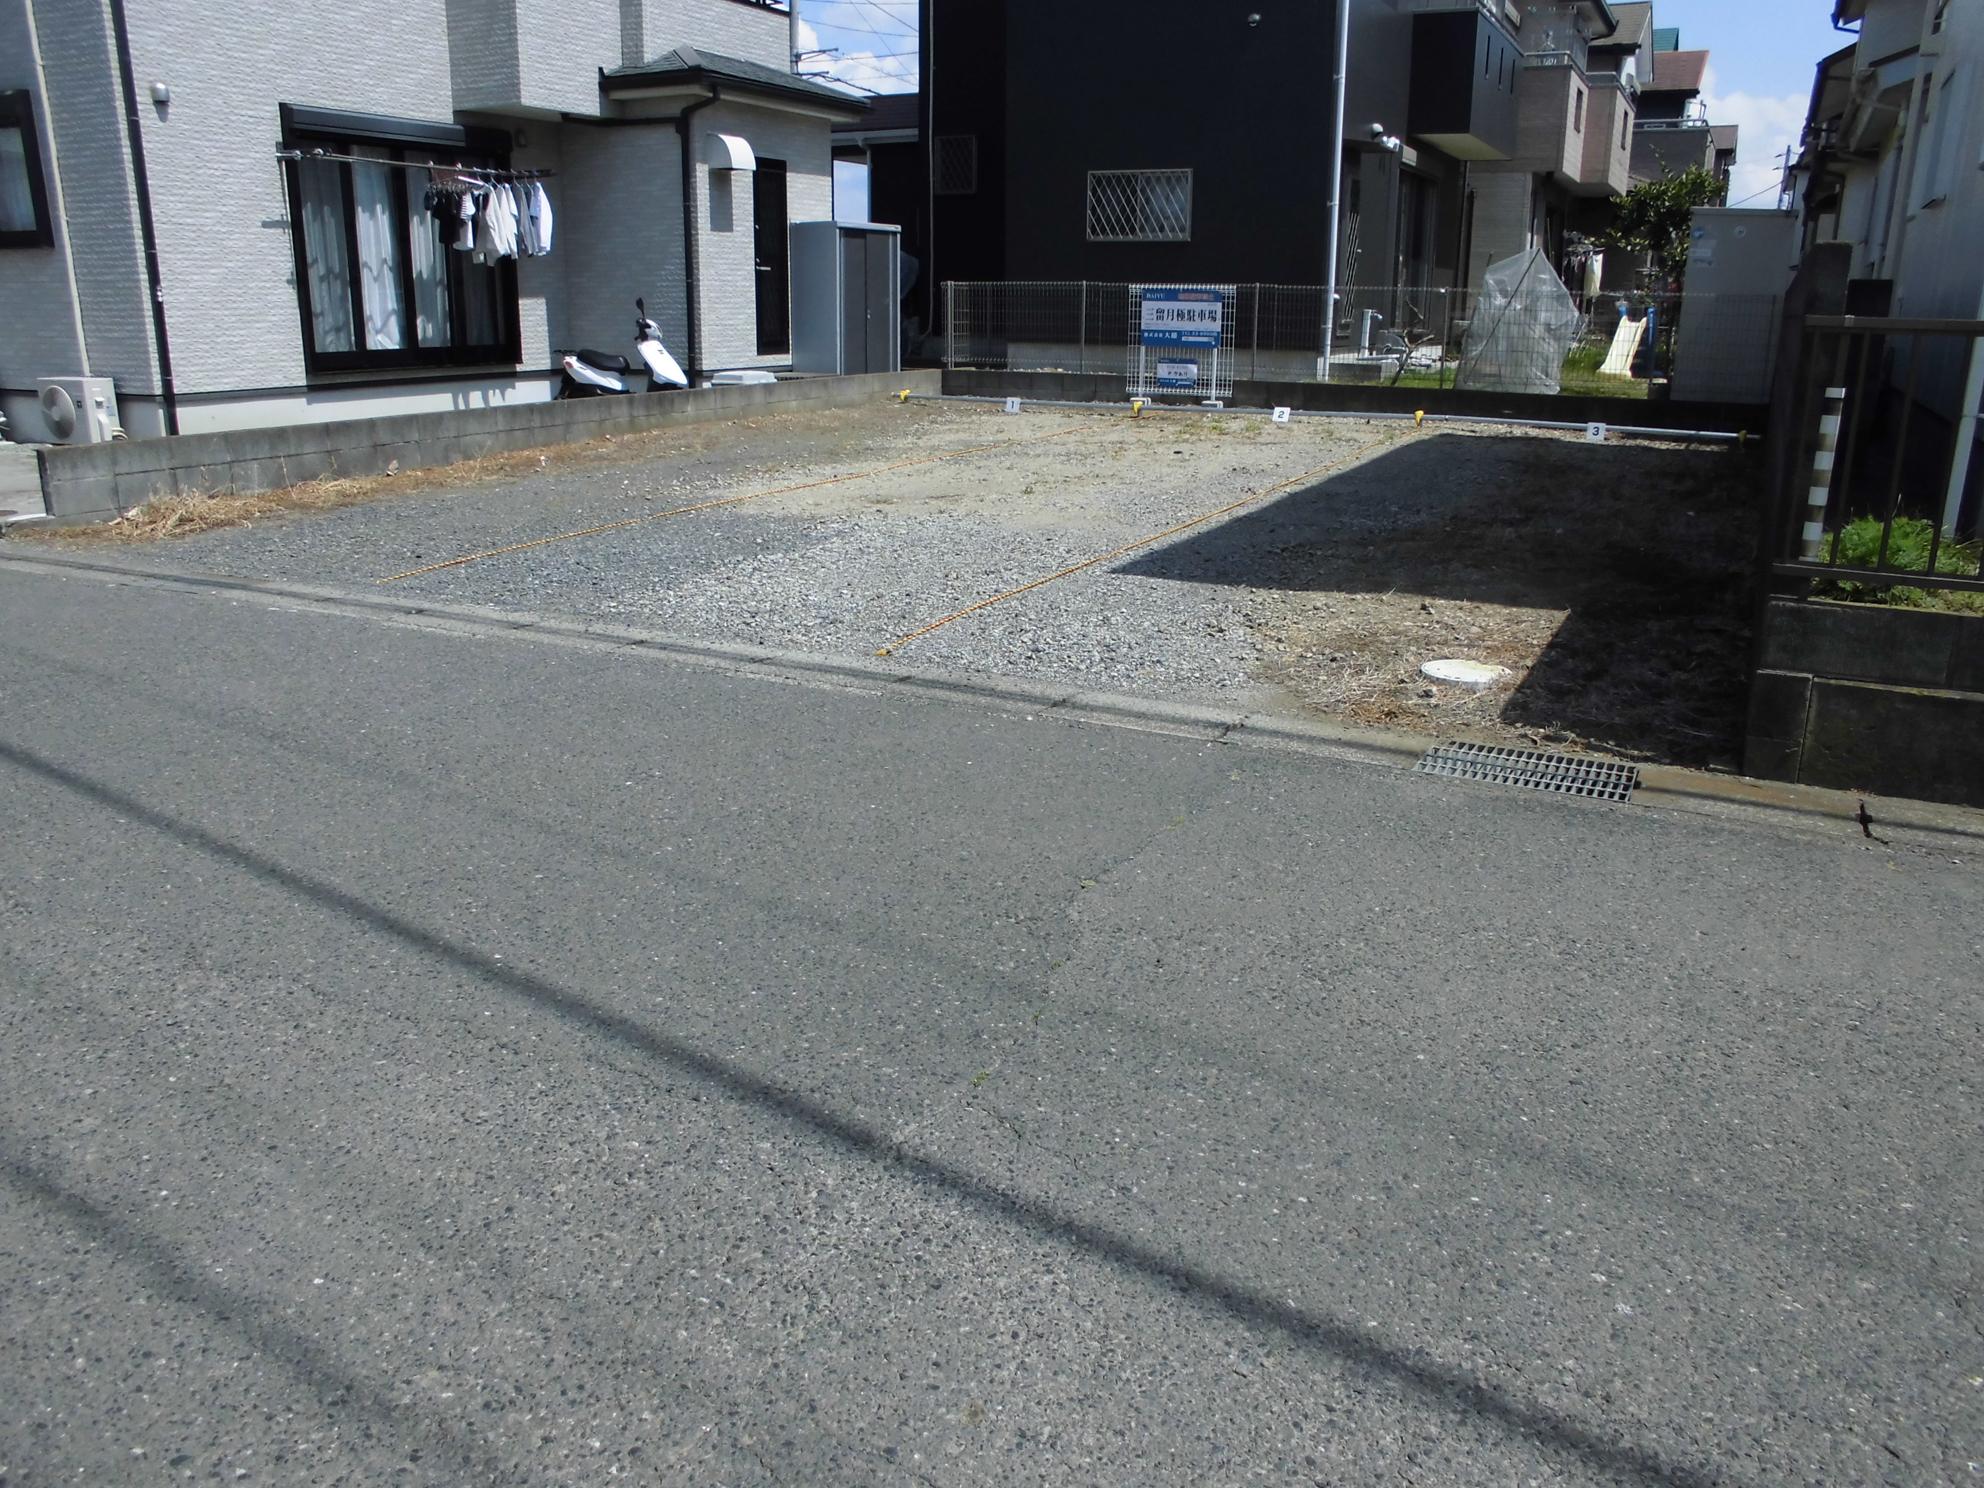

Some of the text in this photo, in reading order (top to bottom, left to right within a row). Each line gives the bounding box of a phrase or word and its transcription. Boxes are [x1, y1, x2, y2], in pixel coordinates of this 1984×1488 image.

[1145, 308, 1217, 322] 三留月極駐車場
[1592, 426, 1600, 436] 3
